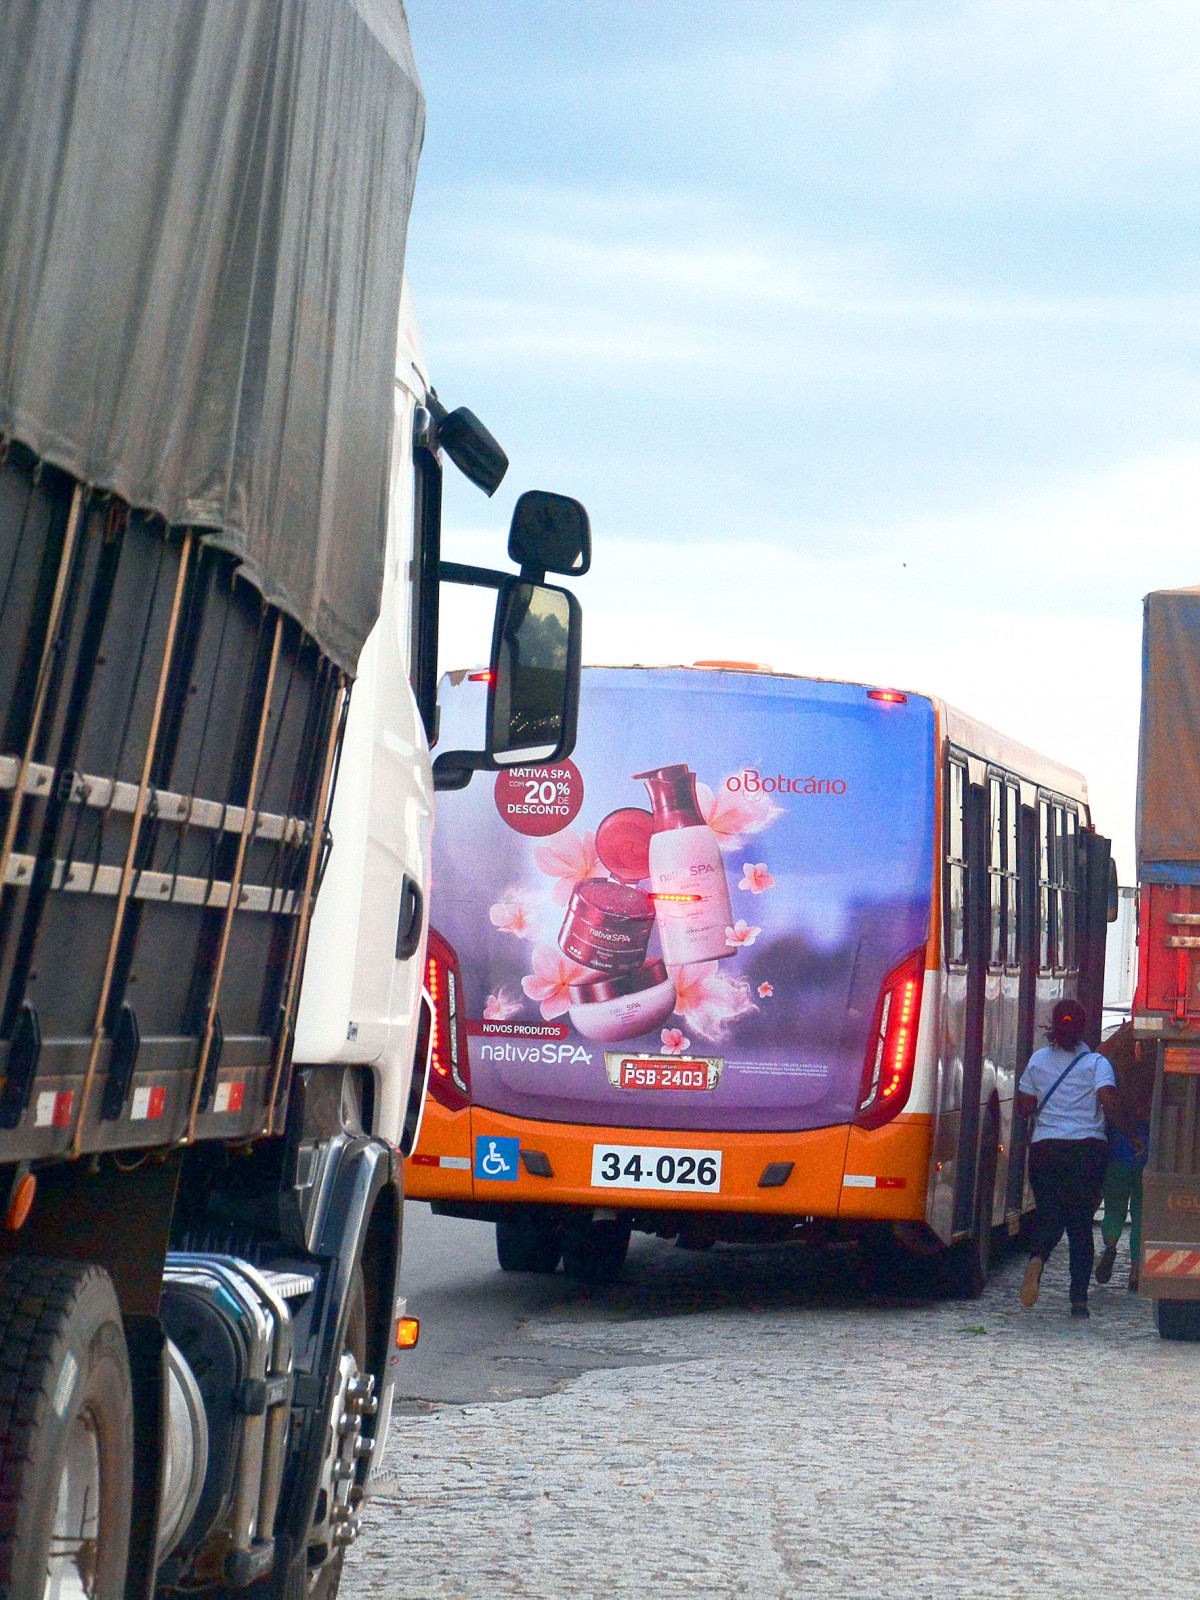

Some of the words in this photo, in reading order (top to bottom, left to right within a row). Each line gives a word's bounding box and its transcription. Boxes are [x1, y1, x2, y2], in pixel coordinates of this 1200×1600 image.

[509, 768, 549, 779] NATIVA
[550, 769, 572, 779] SPA
[726, 769, 847, 795] oBoticário
[524, 780, 571, 805] 20%
[557, 796, 570, 805] DE
[507, 804, 570, 815] DESCONTO
[482, 1024, 513, 1034] NOVOS
[513, 1026, 561, 1036] PRODUTOS
[480, 1042, 593, 1065] nativaSPA
[601, 1152, 717, 1186] 34-026
